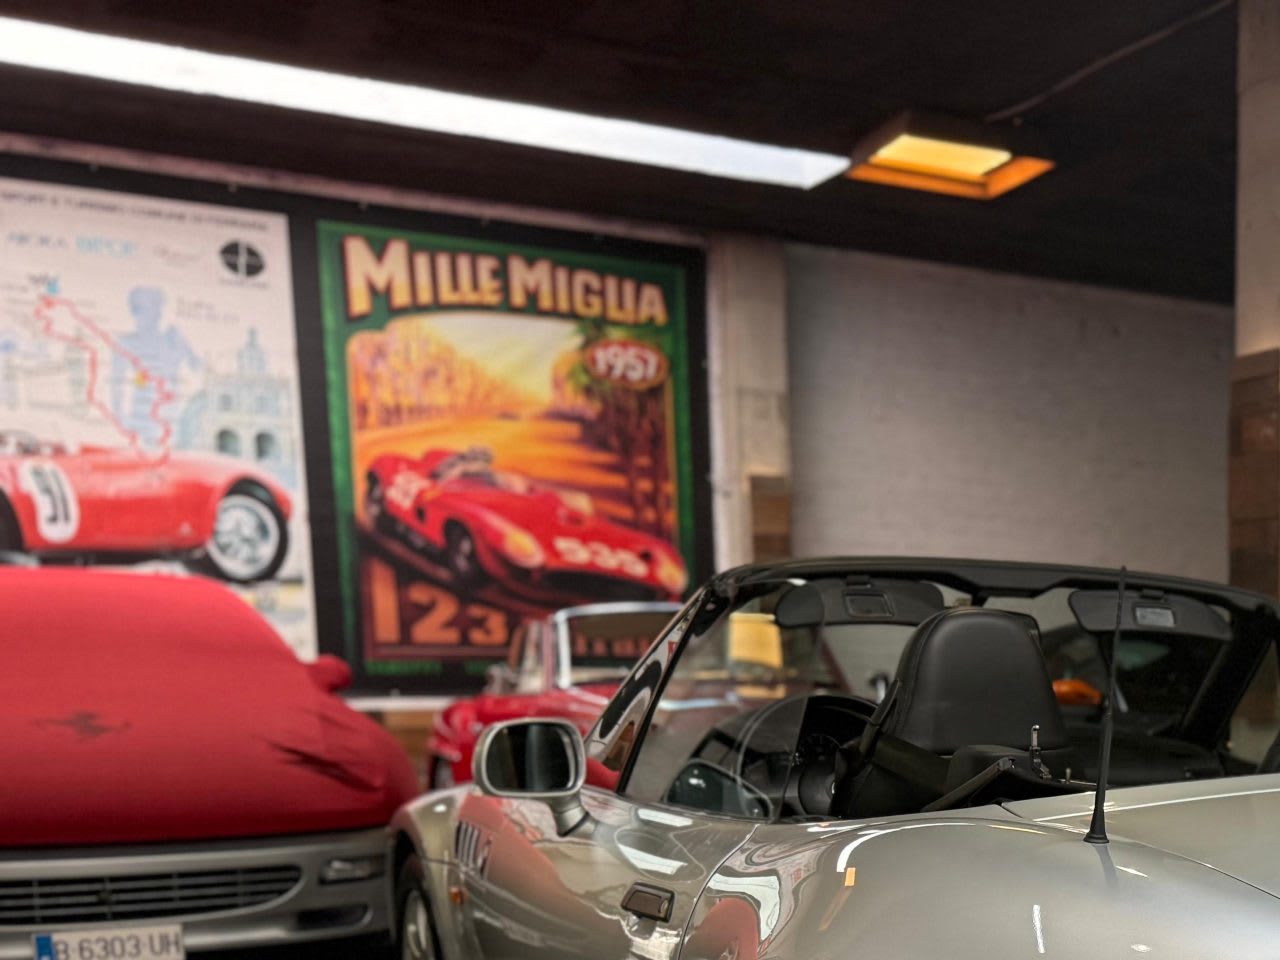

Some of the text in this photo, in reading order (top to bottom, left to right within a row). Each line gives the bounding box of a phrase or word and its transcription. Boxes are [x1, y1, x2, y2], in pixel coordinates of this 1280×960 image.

[343, 236, 669, 326] MILLE MIGLIA
[594, 345, 660, 381] 1957
[79, 934, 142, 960] 6303
[149, 932, 181, 956] UH
